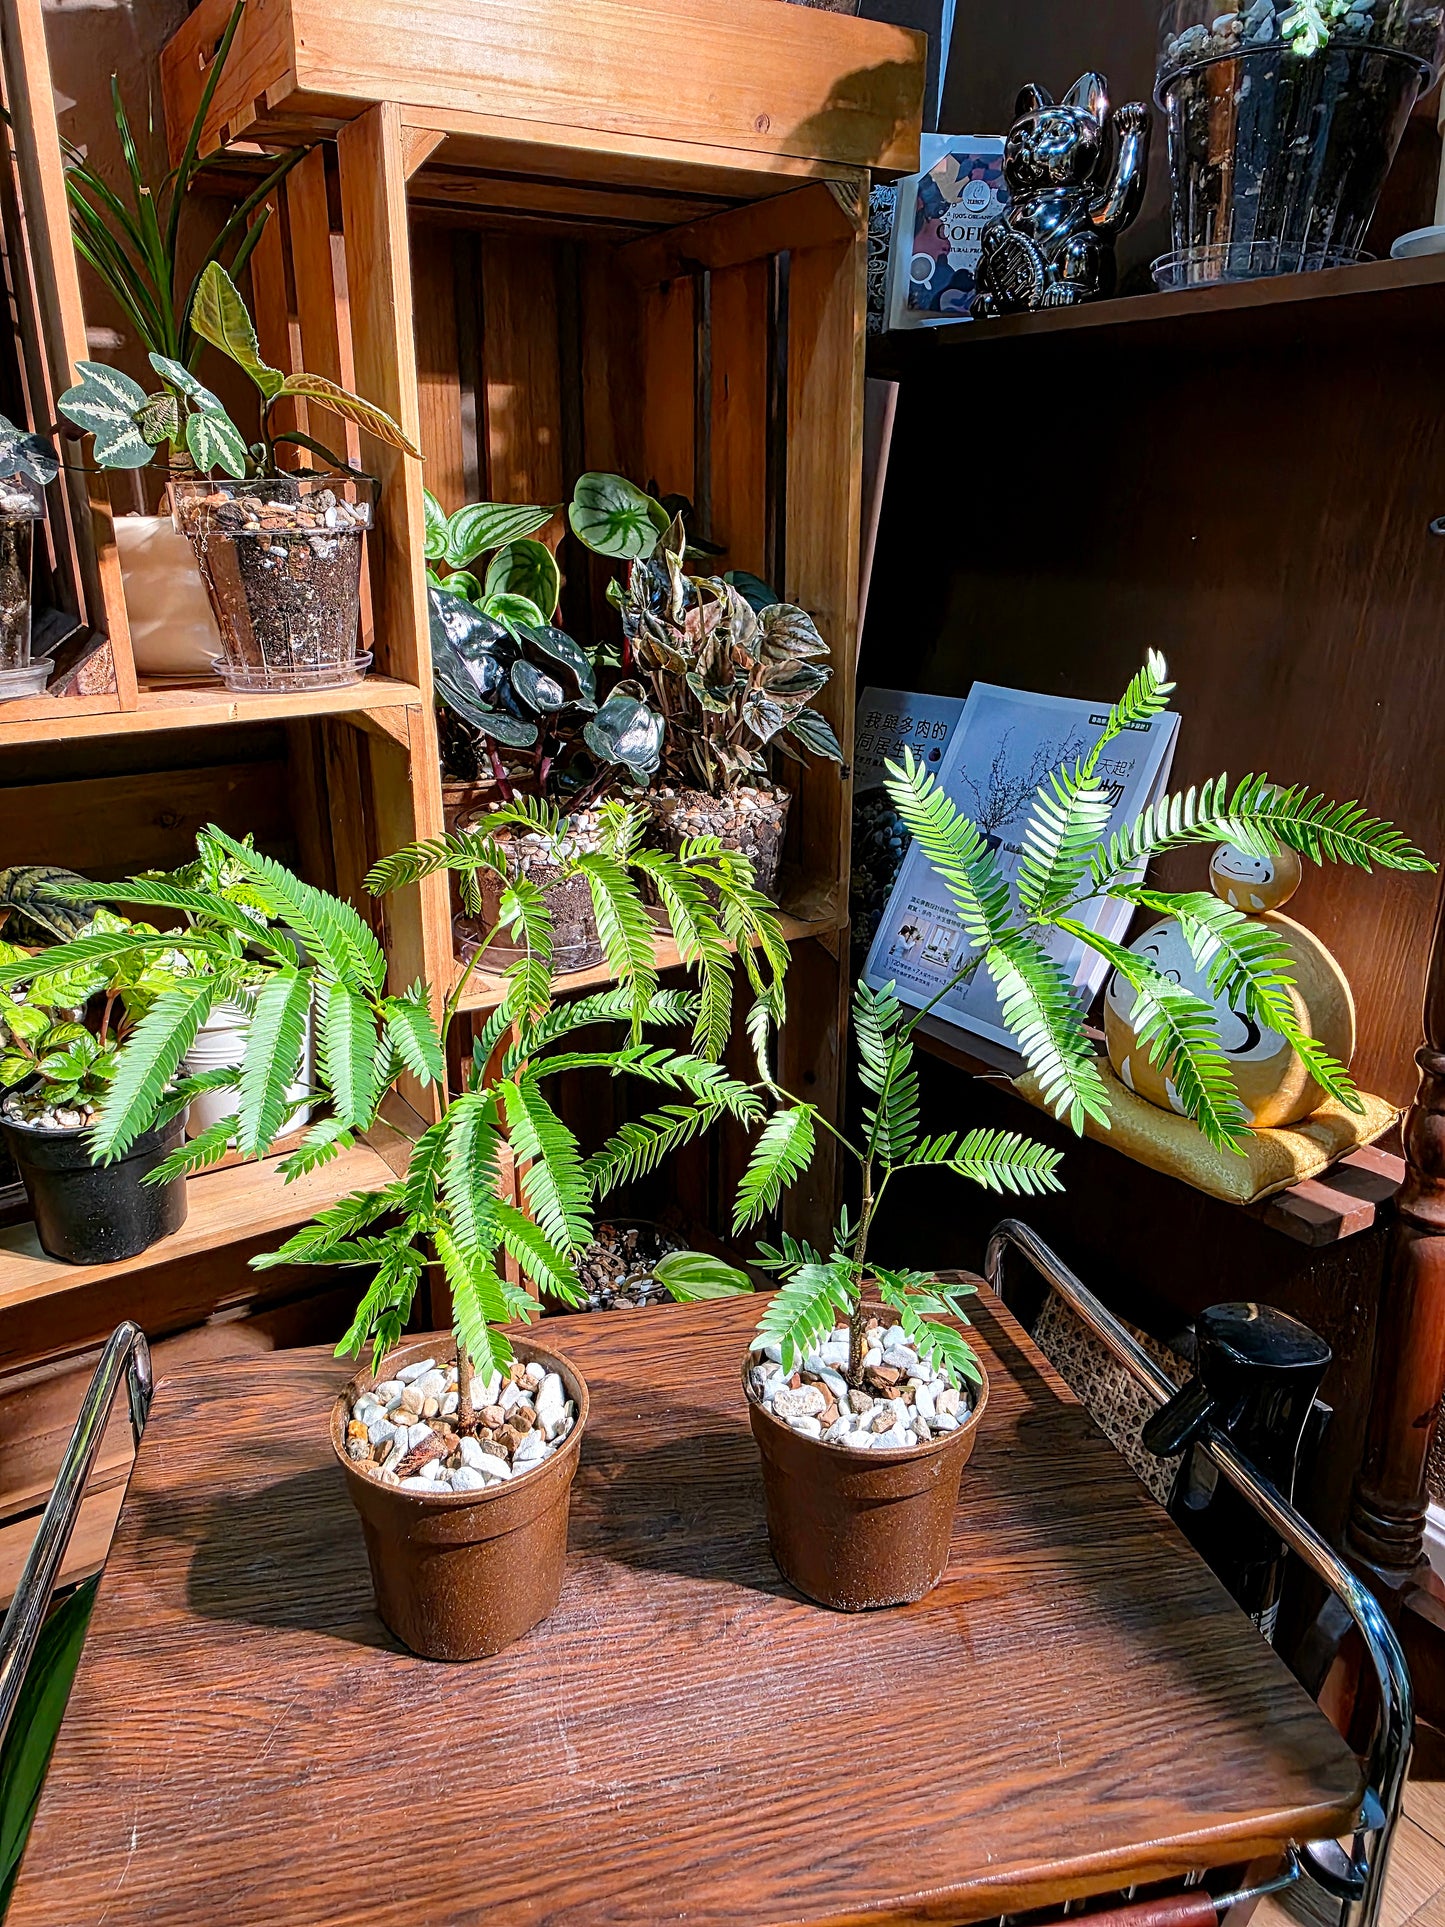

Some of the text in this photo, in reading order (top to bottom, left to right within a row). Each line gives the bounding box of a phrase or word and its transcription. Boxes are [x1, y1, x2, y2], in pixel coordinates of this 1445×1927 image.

[864, 711, 948, 741] 我與多肉的
